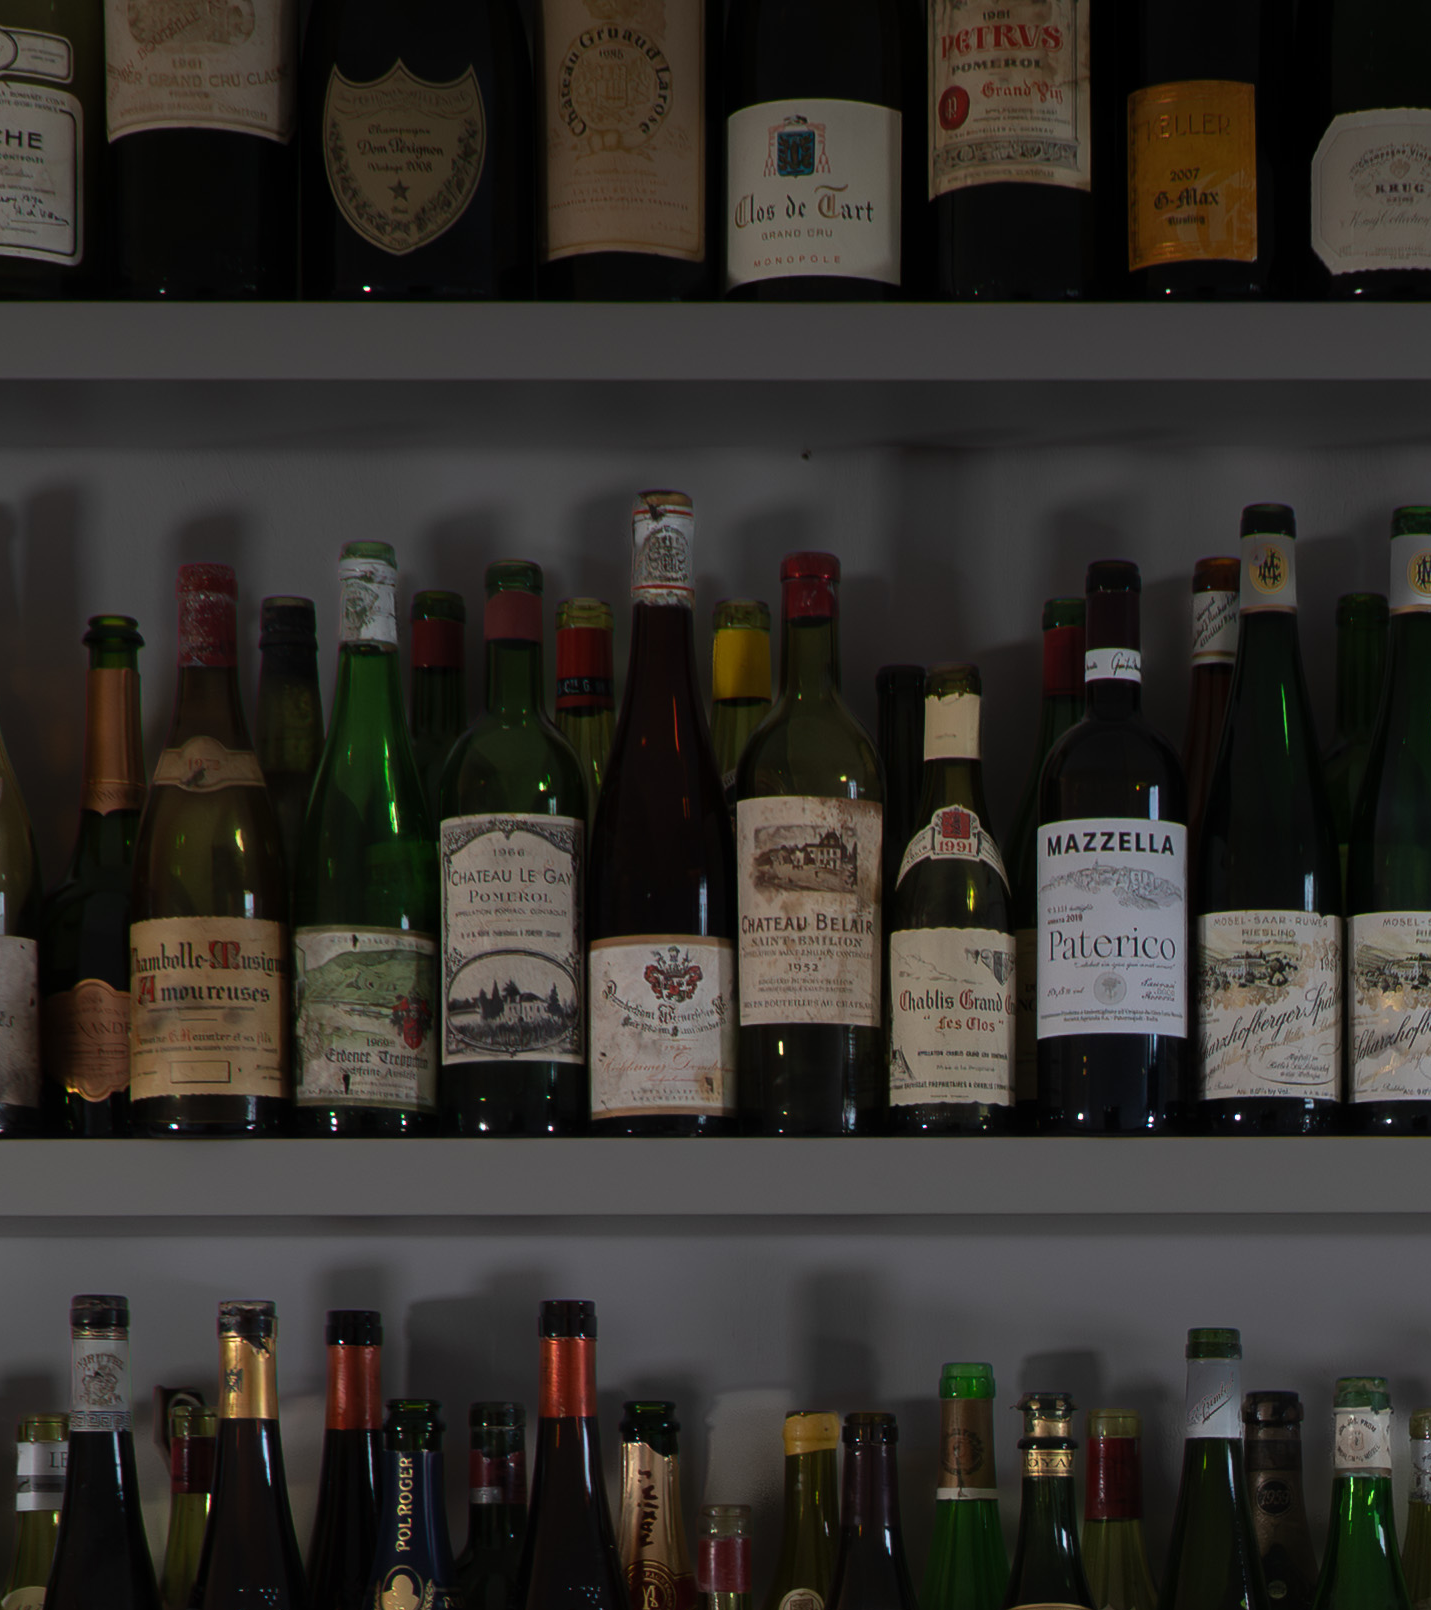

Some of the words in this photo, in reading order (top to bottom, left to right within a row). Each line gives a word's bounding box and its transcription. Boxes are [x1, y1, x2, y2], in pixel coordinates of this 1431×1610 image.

[941, 23, 1064, 59] PETRVS
[950, 57, 1044, 74] POMEROL
[1169, 167, 1200, 181] 2007
[734, 192, 775, 227] Clos
[753, 254, 842, 268] MONOPOLE
[938, 837, 973, 854] 1991
[1047, 833, 1175, 857] MAZZELLA
[451, 868, 513, 887] CHATEAU
[467, 888, 554, 904] POMEROL
[742, 914, 807, 935] CHATEAU
[1048, 930, 1177, 964] Paterico
[787, 960, 819, 973] 1952
